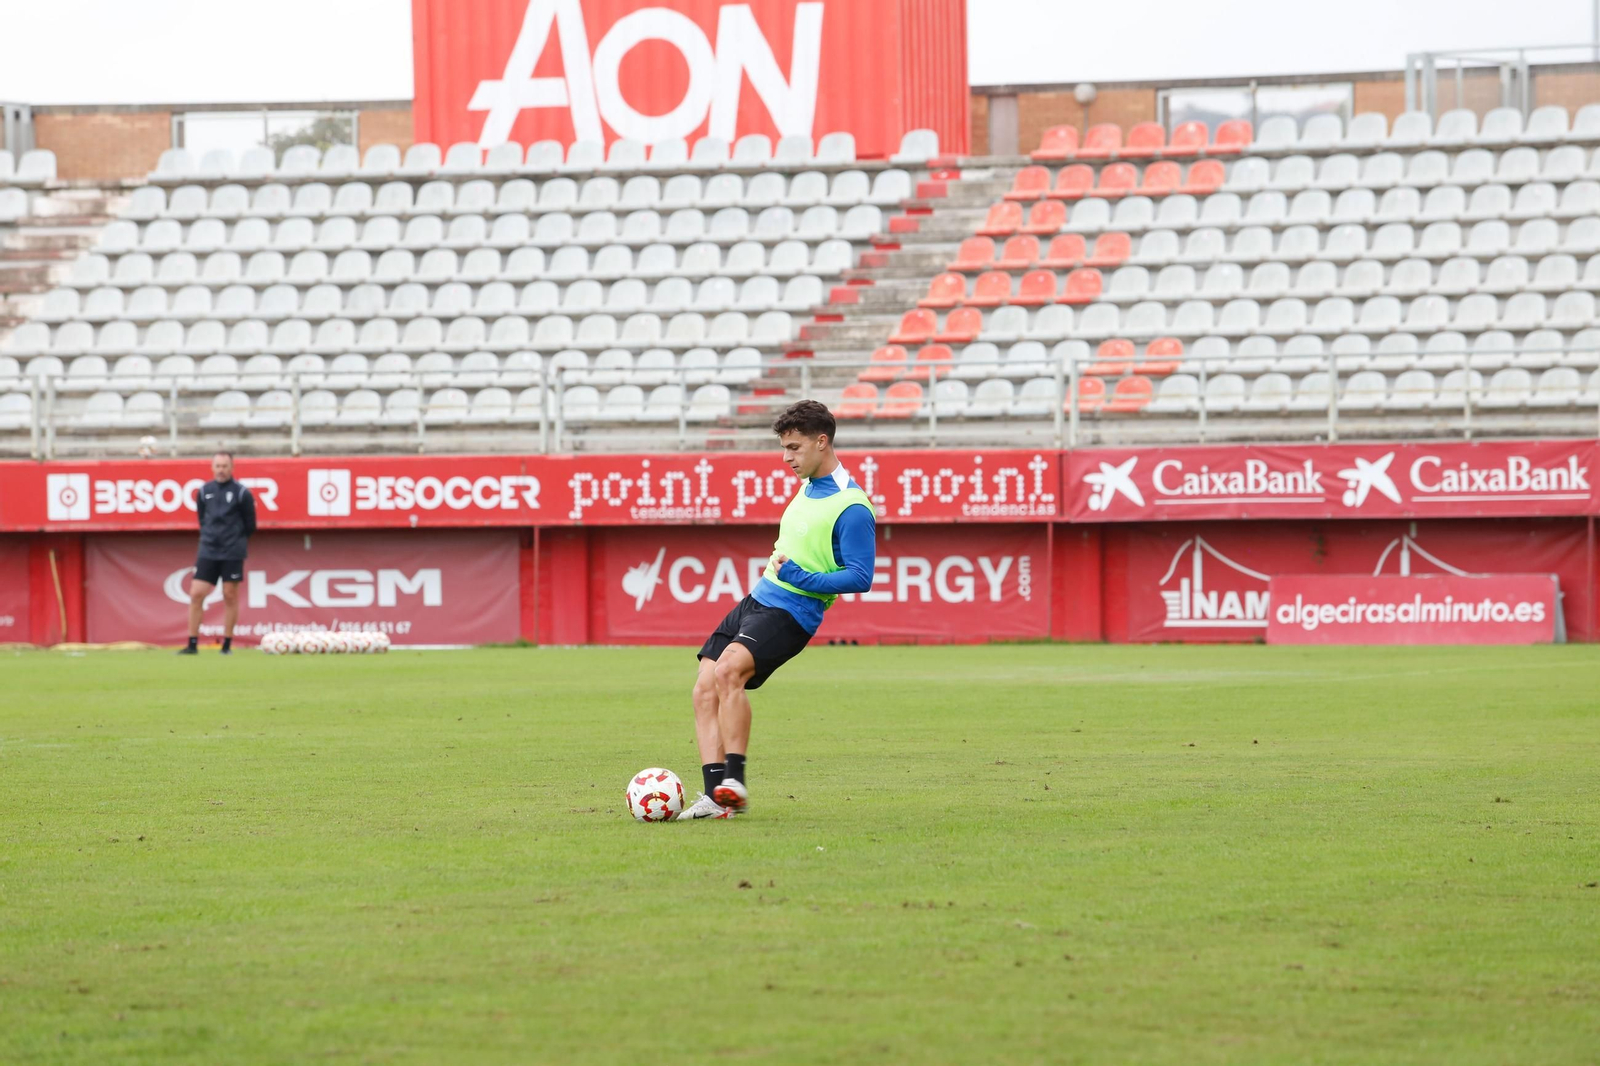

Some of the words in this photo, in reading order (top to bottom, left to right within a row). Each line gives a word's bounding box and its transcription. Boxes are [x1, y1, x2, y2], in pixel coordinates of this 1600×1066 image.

[355, 475, 541, 510] BESOCCER
[567, 458, 721, 519] point
[731, 456, 886, 518] pot
[897, 454, 1055, 516] point
[1152, 459, 1325, 496] CaixaBank
[1409, 455, 1590, 493] CaixaBank
[630, 506, 721, 519] tendencias
[962, 502, 1056, 516] tendencias
[247, 568, 443, 609] KGM
[1276, 593, 1546, 631] algecirasalminuto.es
